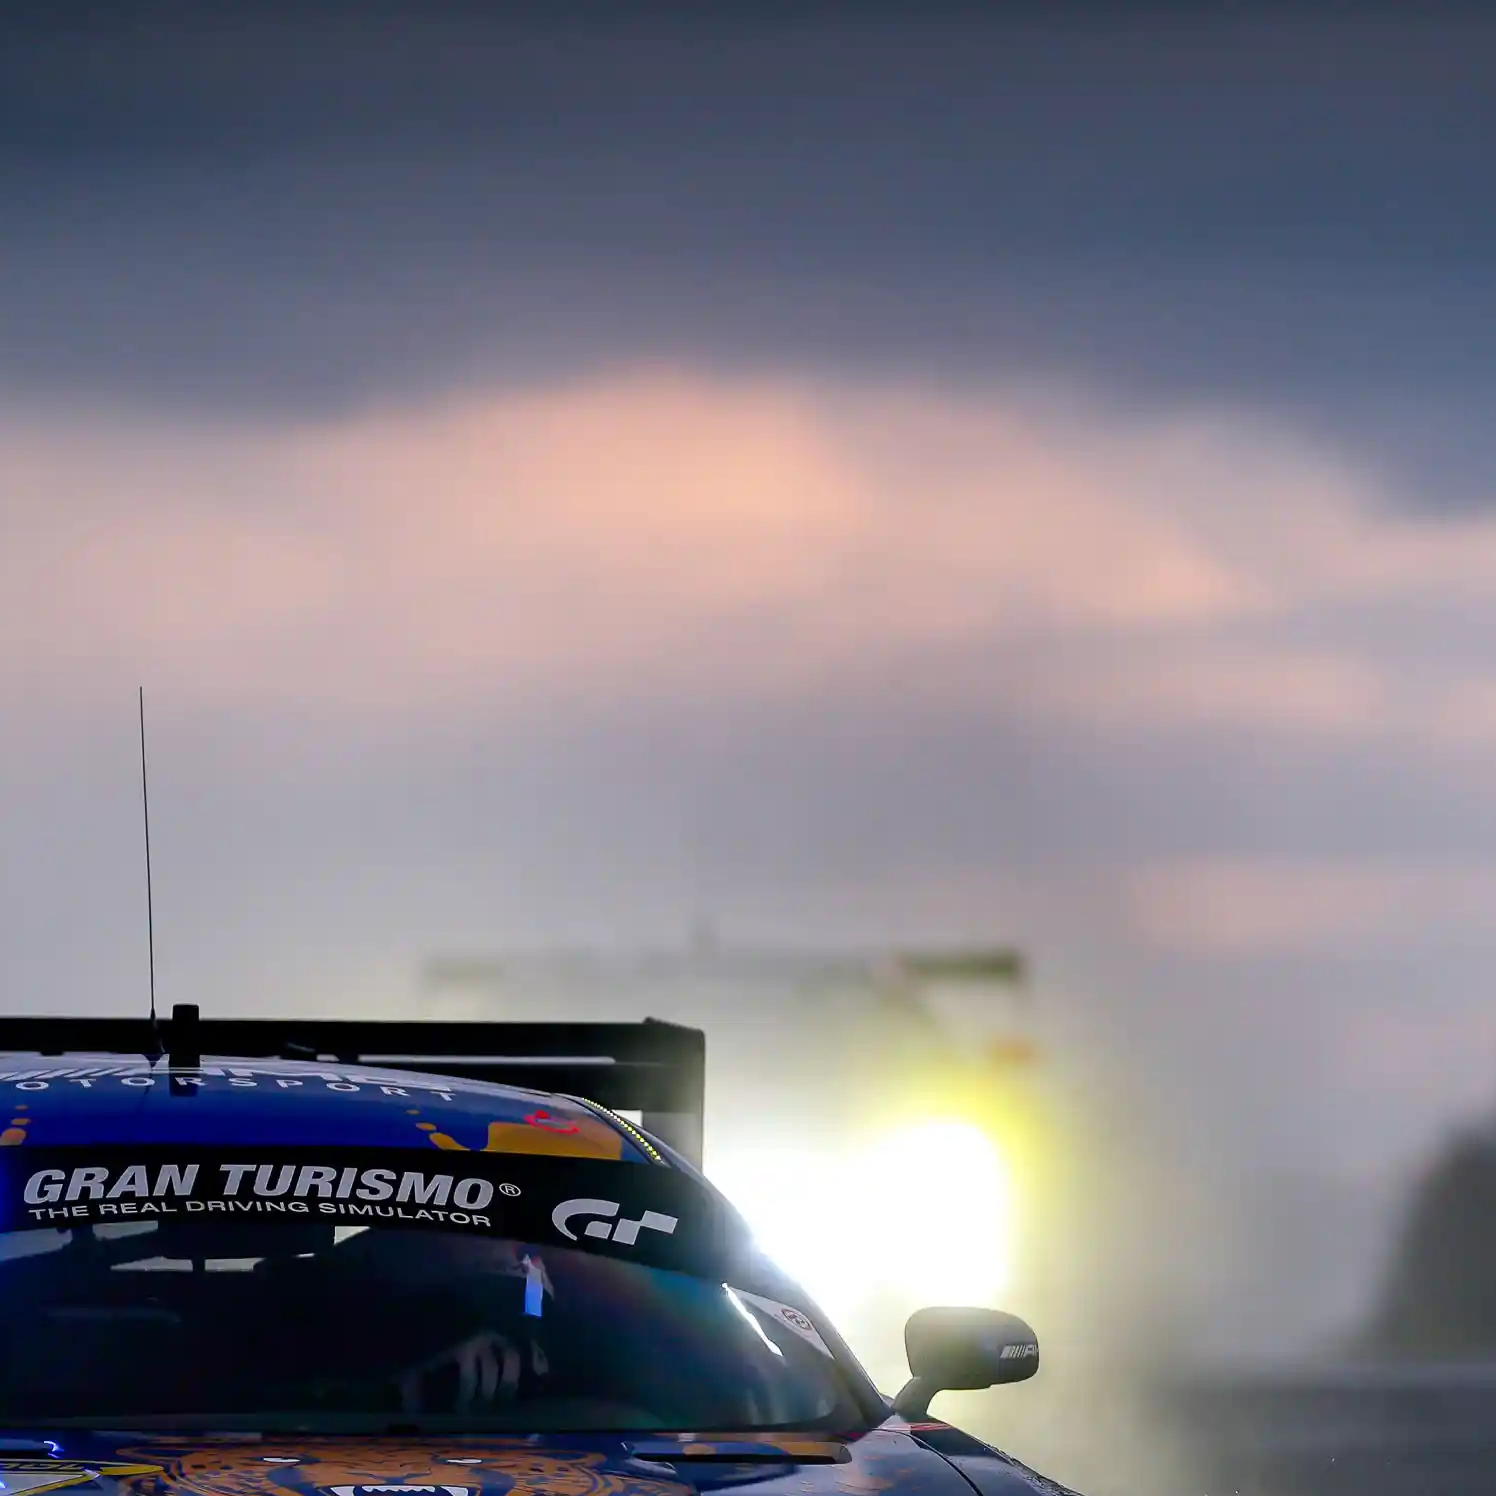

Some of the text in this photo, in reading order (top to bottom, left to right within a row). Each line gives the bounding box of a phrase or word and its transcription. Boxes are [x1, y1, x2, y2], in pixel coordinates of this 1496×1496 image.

[23, 1164, 200, 1204] GRAN
[28, 1200, 492, 1227] THE REAL DRIVING SIMULATOR
